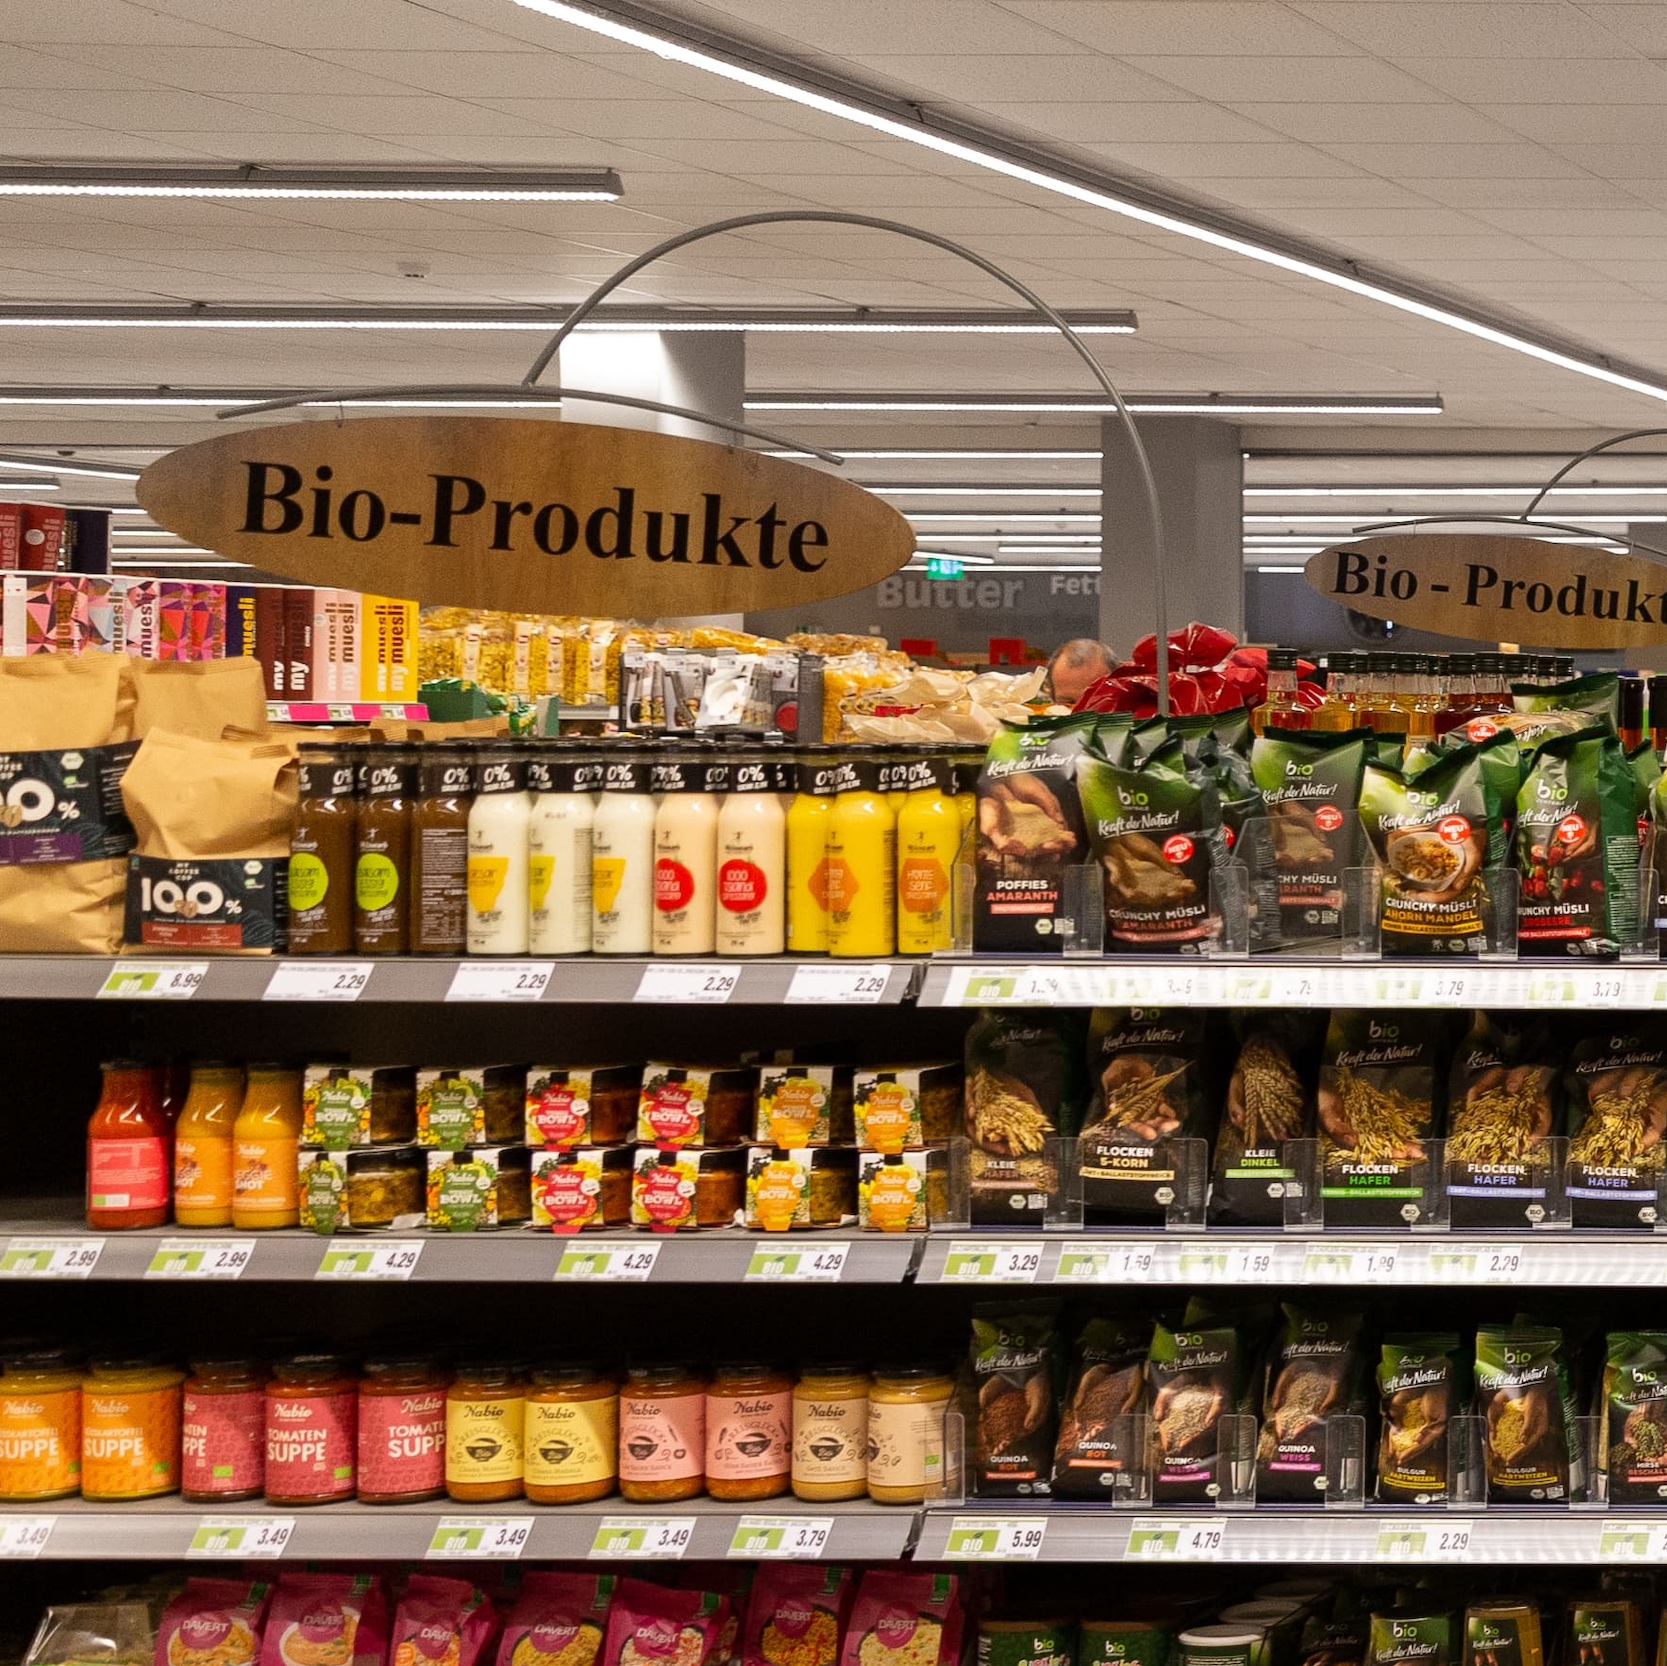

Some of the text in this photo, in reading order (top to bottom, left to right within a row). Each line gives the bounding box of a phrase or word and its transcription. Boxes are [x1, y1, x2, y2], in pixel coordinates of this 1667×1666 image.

[238, 461, 830, 572] Bio-Produkte
[1333, 551, 1418, 601] Bio
[877, 576, 1024, 609] Butter
[371, 768, 398, 786] 0%
[484, 765, 511, 783] 0%
[1117, 787, 1149, 806] bio
[996, 880, 1048, 890] POFFIES
[142, 878, 243, 915] 100 %
[986, 892, 1058, 901] AMARANTH
[1385, 910, 1477, 923] AHORN MANDEL
[171, 973, 202, 988] 8.99
[335, 975, 365, 990] 2.29
[1096, 1146, 1153, 1157] FLOCKEN
[1244, 1148, 1275, 1157] KLEIE
[1100, 1158, 1148, 1168] 5-KORN
[1240, 1158, 1279, 1167] DINKEL
[1342, 1164, 1398, 1174] FLOCKEN
[1348, 1175, 1391, 1185] HAFER
[66, 1251, 96, 1268] 2.99
[959, 1255, 1038, 1274] BIO 3.29
[274, 1403, 312, 1418] Nabio
[268, 1429, 326, 1440] TOMATEN
[267, 1441, 325, 1460] SUPPE
[205, 1529, 288, 1549] BIO 3.49
[960, 1531, 1042, 1552] BIO 5.99
[183, 1620, 228, 1633] DAVERT
